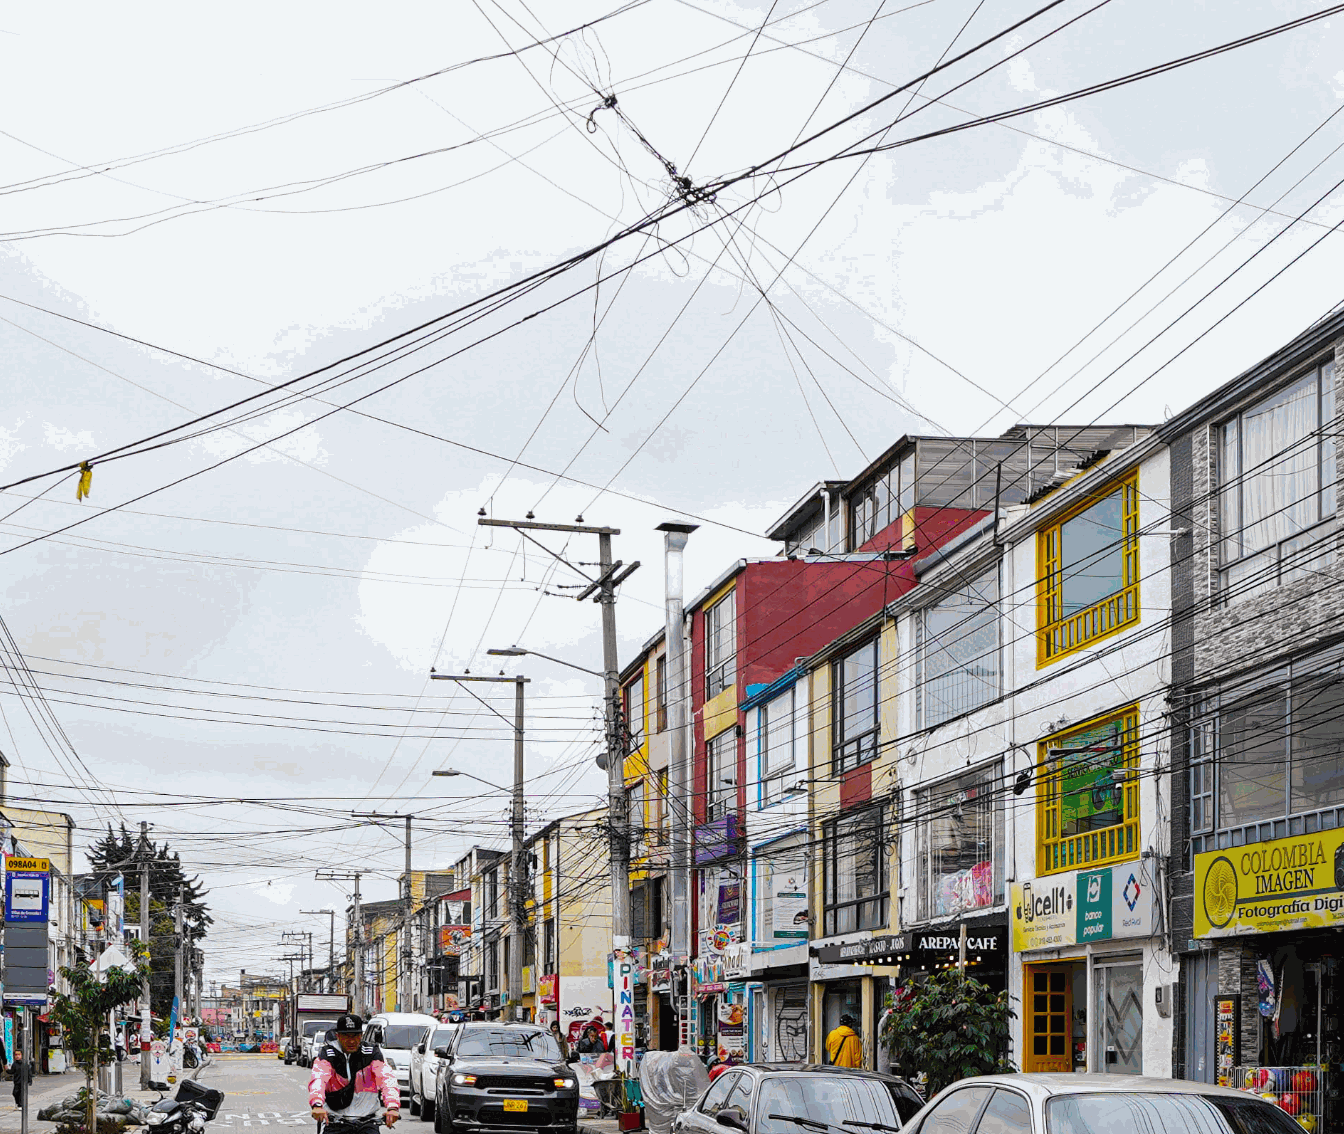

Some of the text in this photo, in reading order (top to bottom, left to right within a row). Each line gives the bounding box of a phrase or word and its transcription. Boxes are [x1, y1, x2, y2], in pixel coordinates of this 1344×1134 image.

[8, 860, 37, 869] 098A04
[1240, 840, 1328, 876] COLOMBIA
[1255, 868, 1316, 895] IMAGEN
[1085, 911, 1103, 921] banco
[1083, 922, 1105, 937] popular
[918, 936, 959, 950] AREPA
